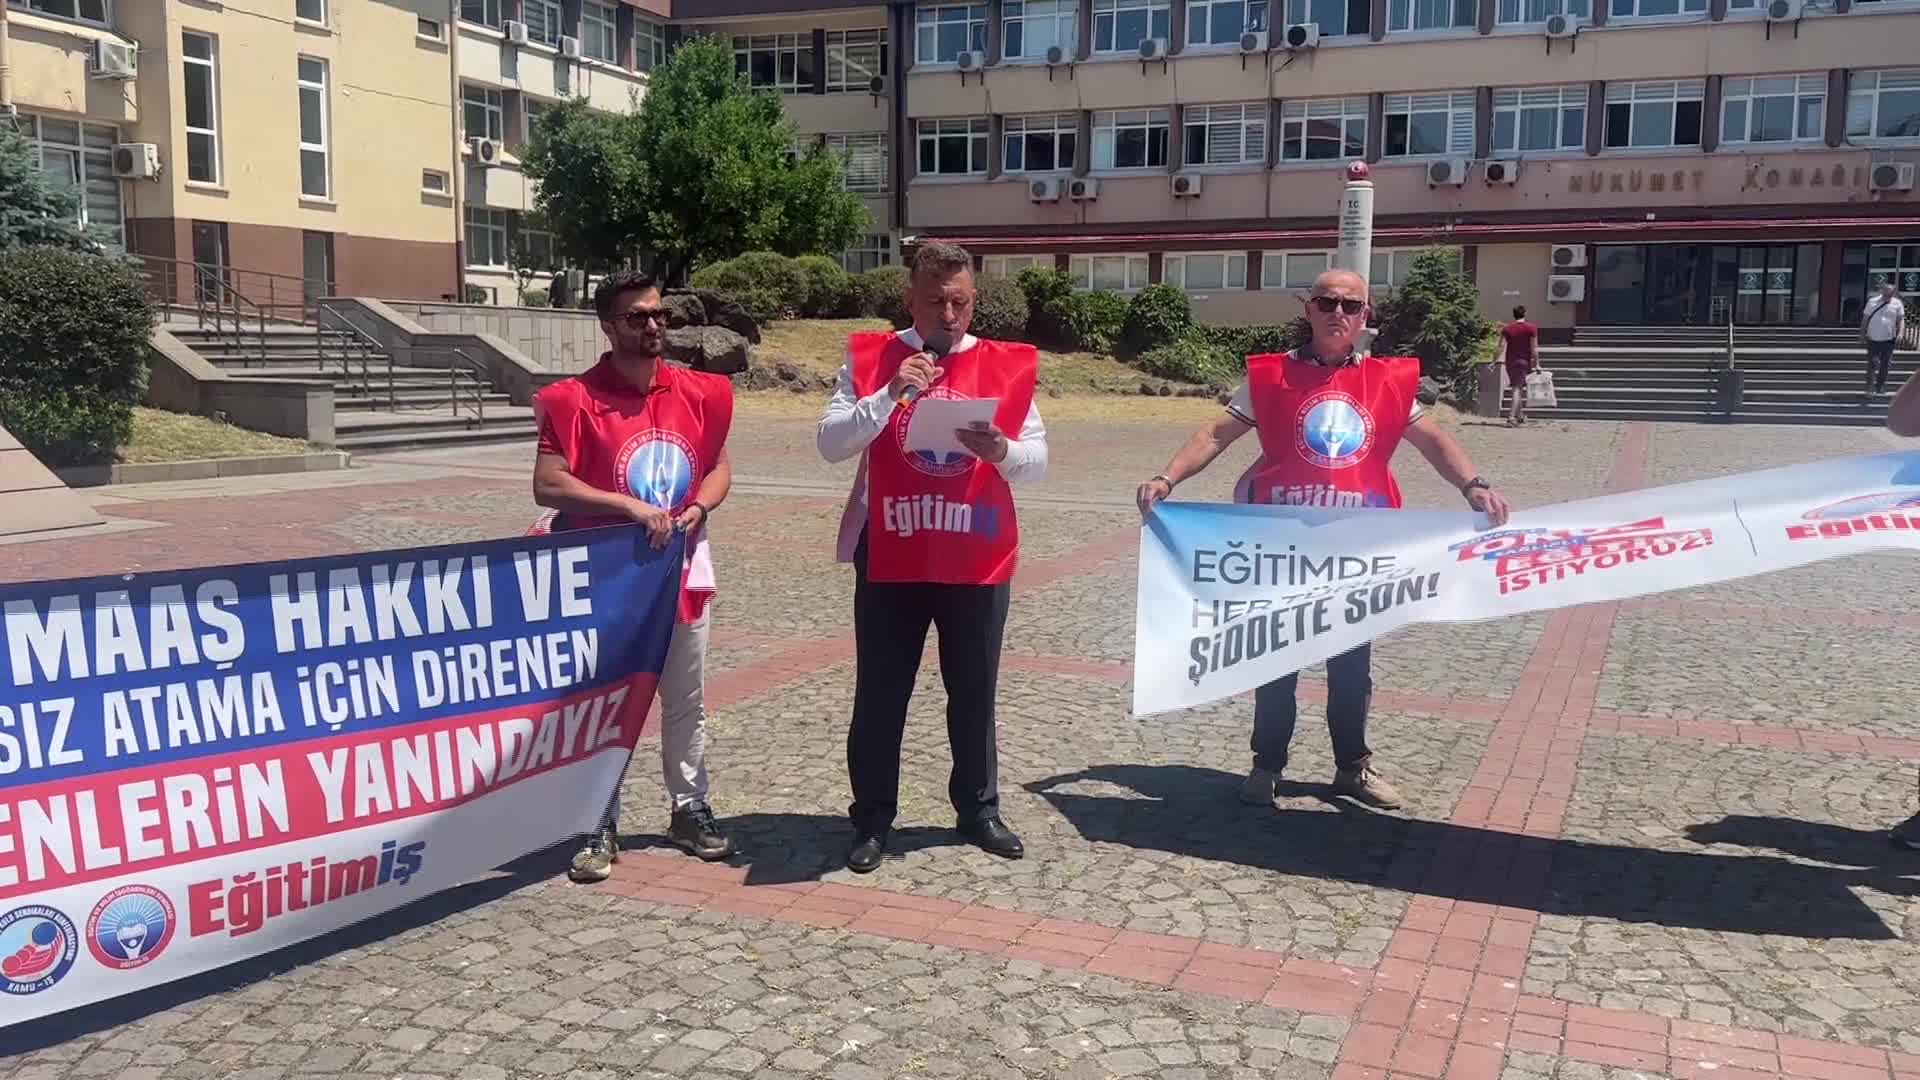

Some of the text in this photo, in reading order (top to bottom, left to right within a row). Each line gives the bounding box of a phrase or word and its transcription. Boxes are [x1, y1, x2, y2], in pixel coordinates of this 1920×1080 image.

[3, 545, 593, 686] MAAŞ HAKKI VE
[1193, 540, 1397, 586] EĞİTİMDE
[103, 671, 286, 758] ATAMA
[297, 655, 401, 731] İÇİN
[411, 628, 599, 710] DİRENEN
[1188, 572, 1441, 687] ŞİDDETE SON!
[306, 686, 630, 823] YANINDAYIZ
